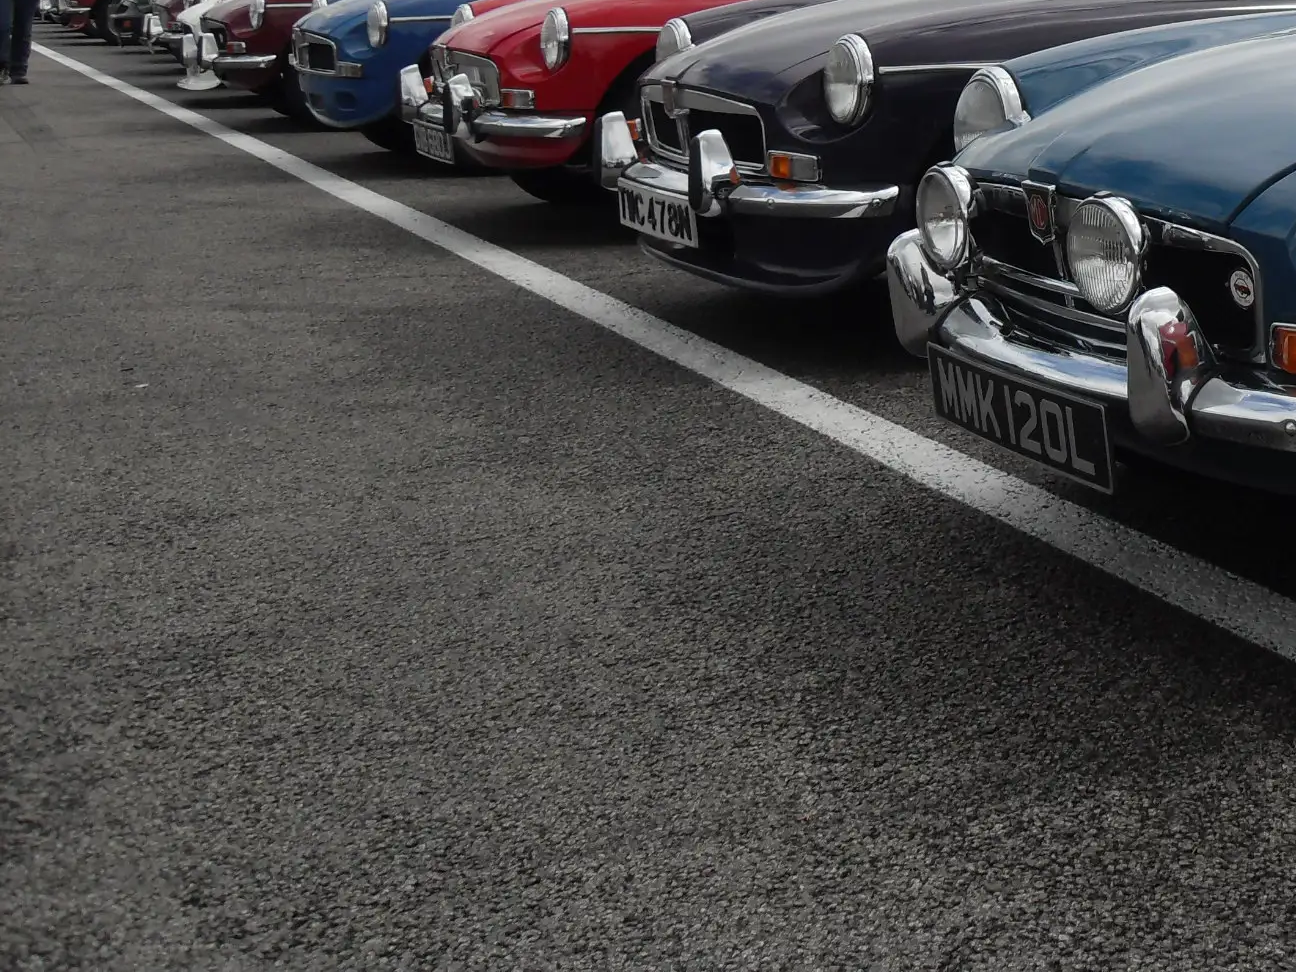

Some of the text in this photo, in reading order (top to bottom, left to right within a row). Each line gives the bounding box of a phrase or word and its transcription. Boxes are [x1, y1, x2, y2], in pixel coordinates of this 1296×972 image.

[647, 196, 693, 241] 478N
[937, 357, 1096, 476] MMK 120L
